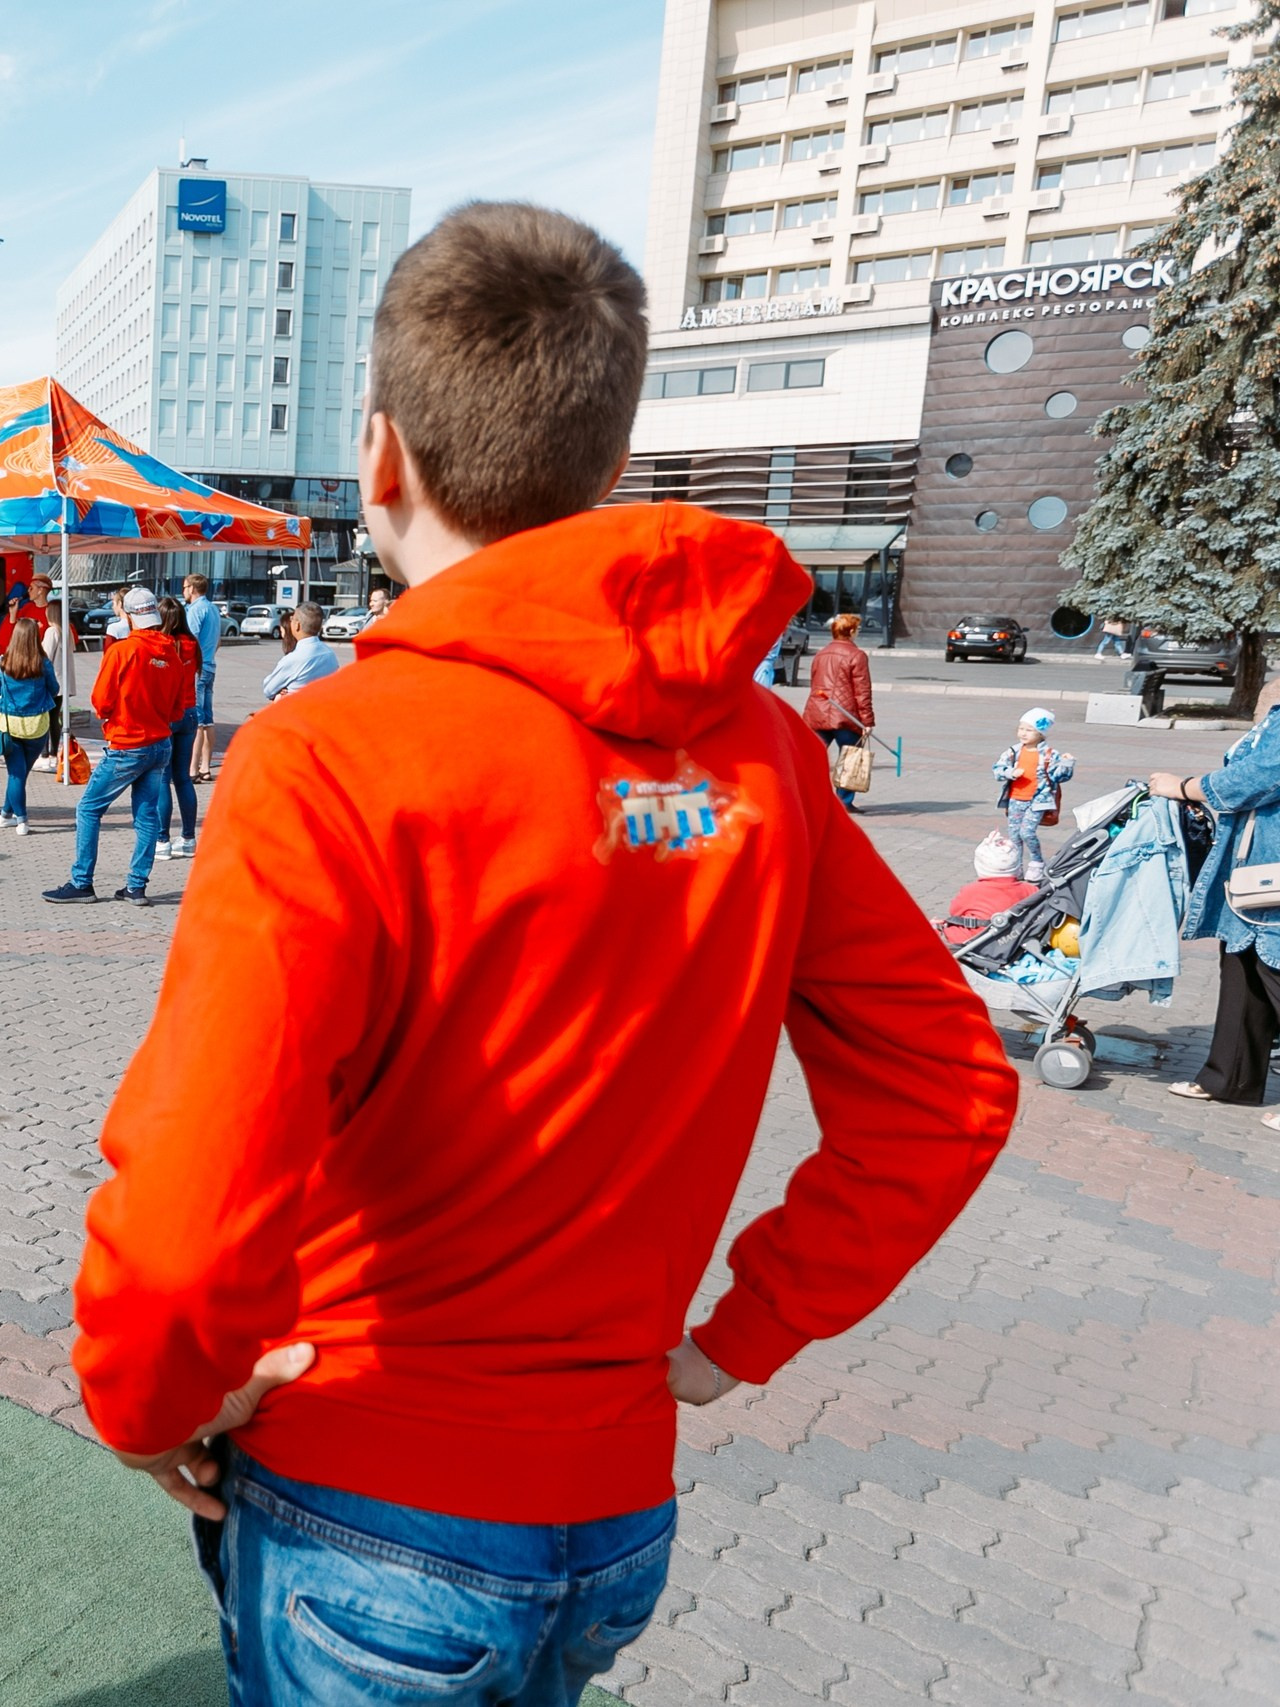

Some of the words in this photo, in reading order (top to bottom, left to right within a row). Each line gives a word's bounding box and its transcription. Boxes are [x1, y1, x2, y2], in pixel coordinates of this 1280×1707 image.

[181, 212, 222, 223] NOVOTEL
[940, 259, 1175, 307] КРАСНОЯРСК
[940, 307, 1035, 328] КОМПЛЕКС
[1041, 298, 1158, 317] РЕСТОРАНО
